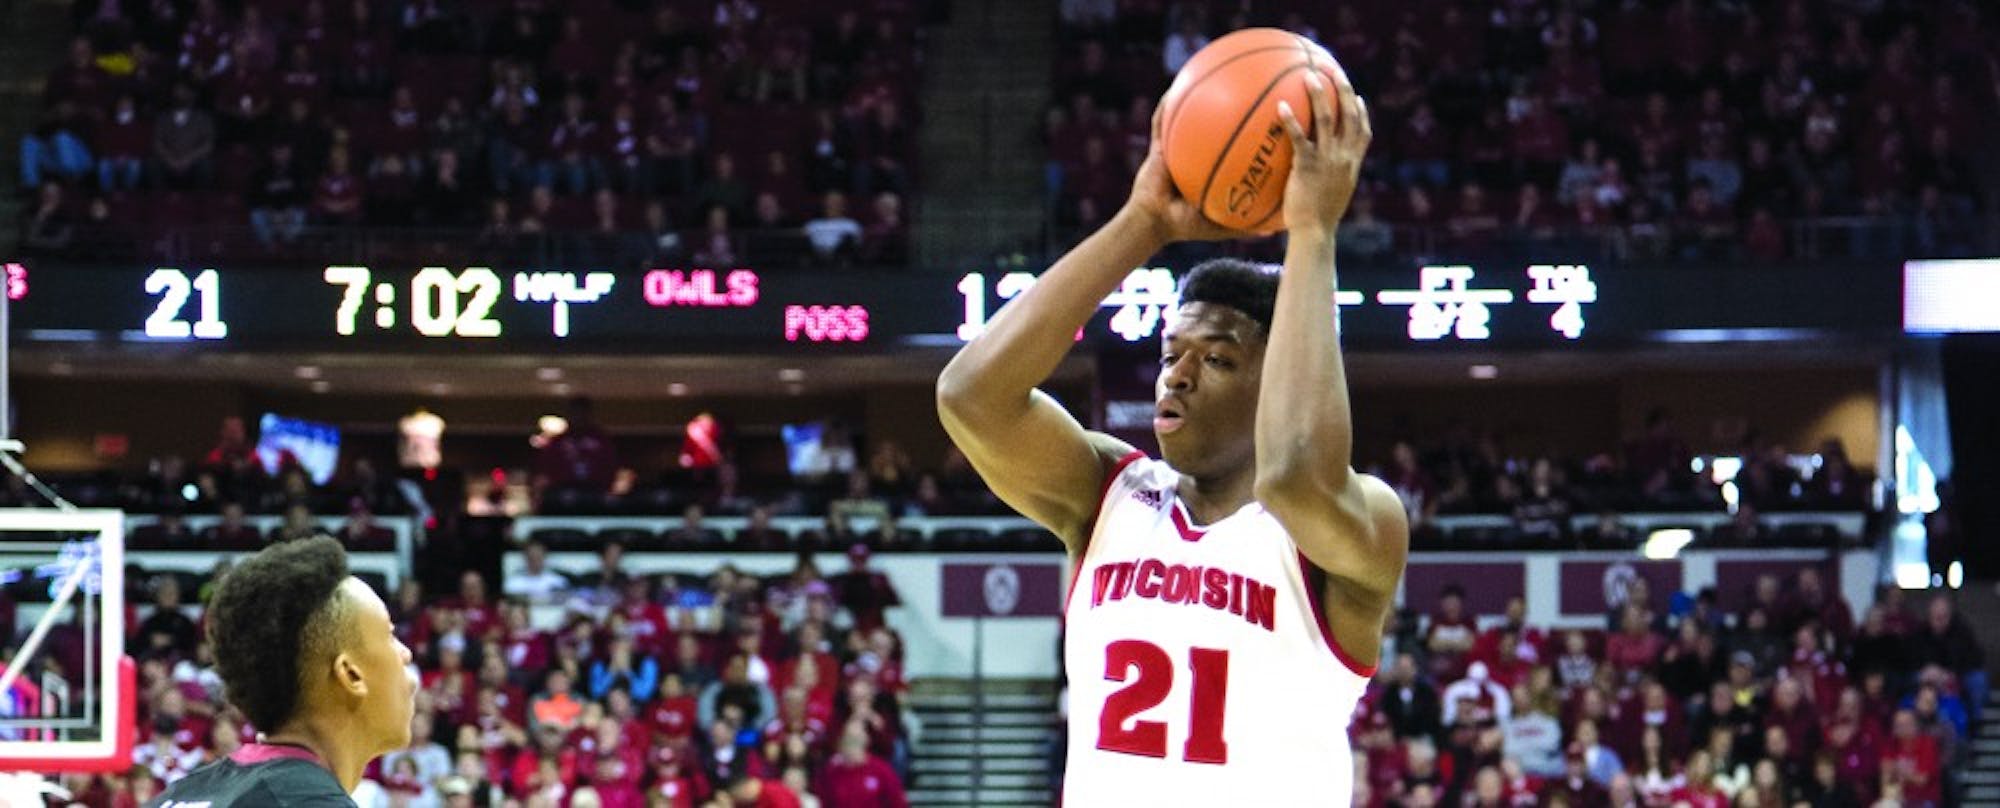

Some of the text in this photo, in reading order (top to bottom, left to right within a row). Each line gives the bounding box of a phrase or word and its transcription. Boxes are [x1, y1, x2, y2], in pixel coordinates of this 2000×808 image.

[145, 268, 227, 338] 21
[324, 266, 502, 336] 7:02
[643, 269, 759, 306] OWLS
[784, 305, 870, 342] POSS
[1091, 558, 1277, 632] WICONSIN
[1096, 638, 1230, 766] 21
